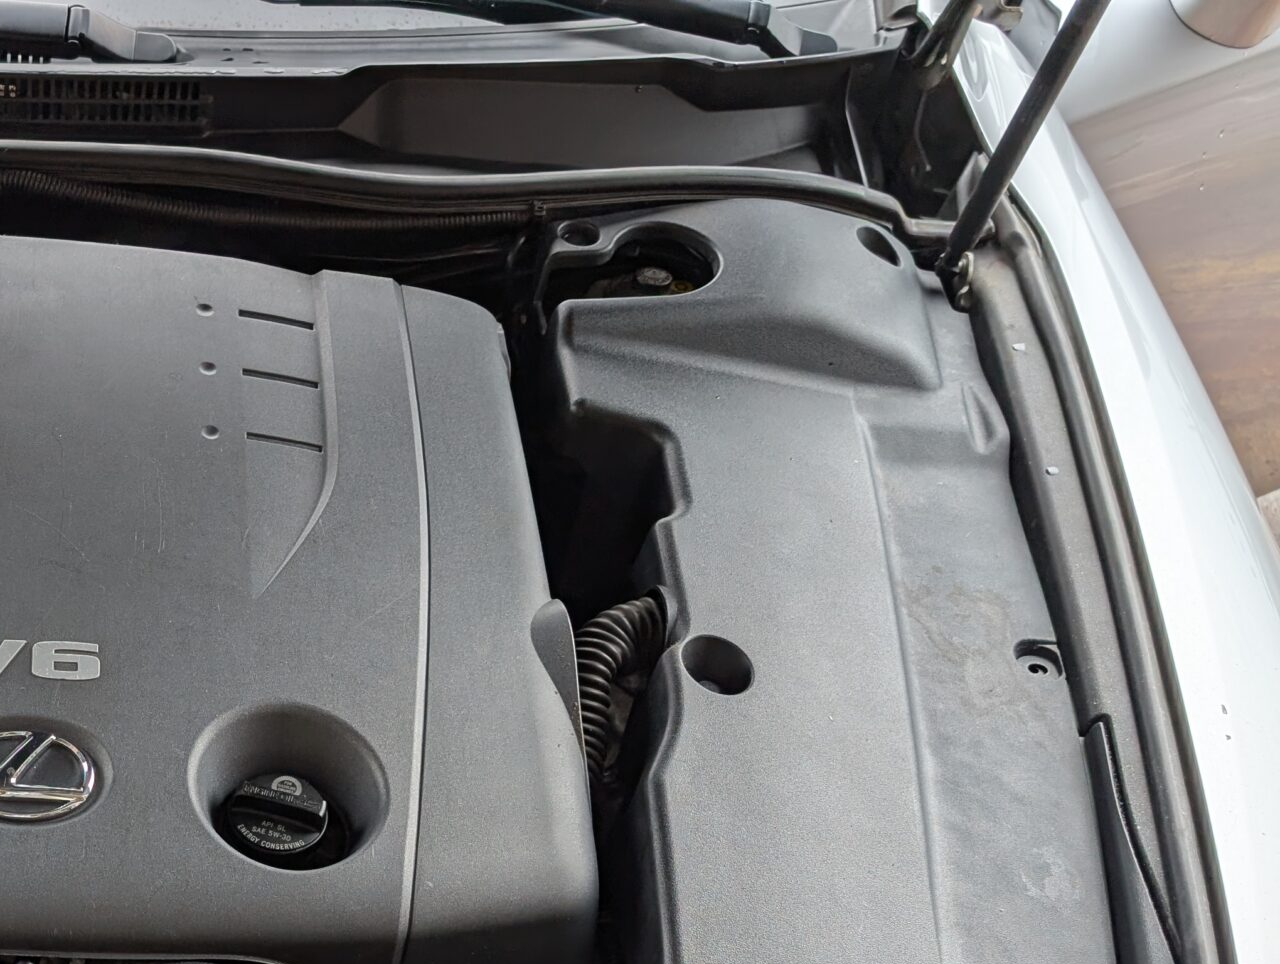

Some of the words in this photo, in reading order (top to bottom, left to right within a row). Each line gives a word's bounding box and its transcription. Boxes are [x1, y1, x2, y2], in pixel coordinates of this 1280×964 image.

[237, 824, 260, 844] ENERGY
[261, 840, 305, 850] CONSERVING
[252, 826, 266, 835] SAE
[268, 830, 292, 841] 5W-30
